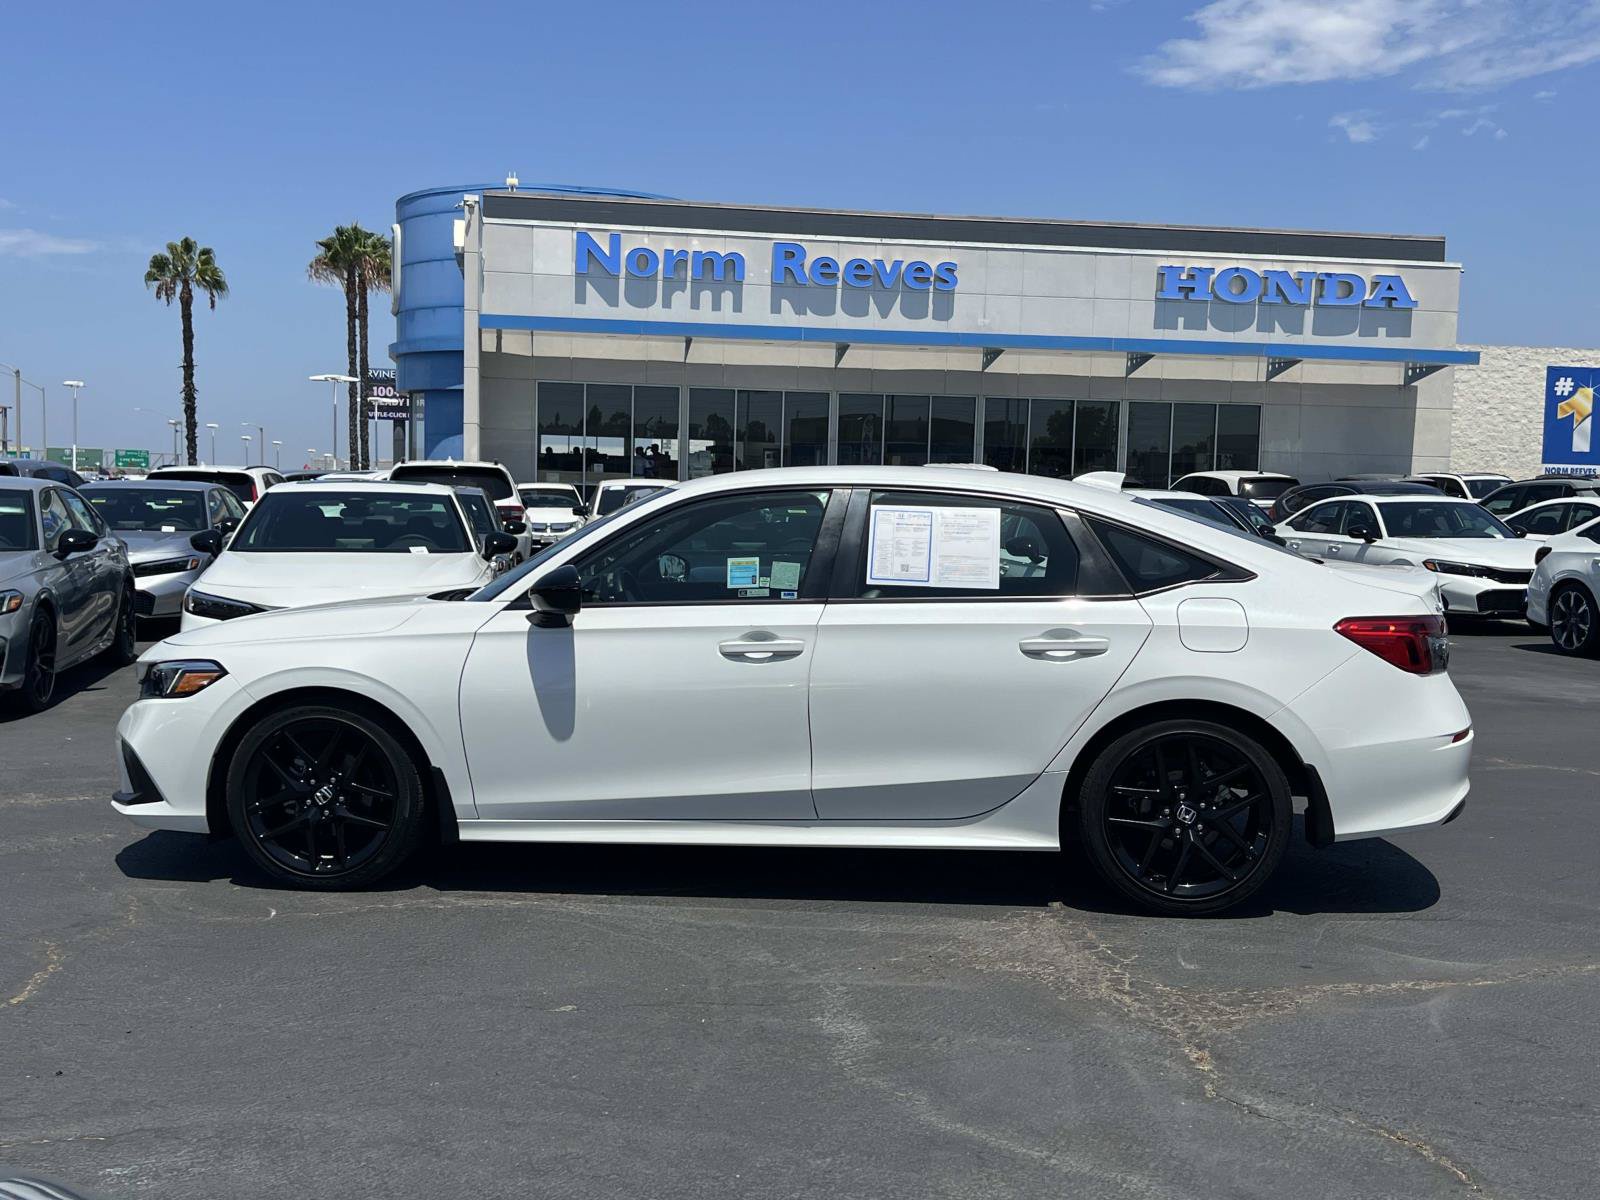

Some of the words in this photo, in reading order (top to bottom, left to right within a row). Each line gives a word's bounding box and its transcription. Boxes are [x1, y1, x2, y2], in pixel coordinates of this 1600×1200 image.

[575, 231, 746, 281] Norm
[772, 241, 959, 290] Reeves
[1156, 265, 1419, 308] HONDA
[1544, 467, 1569, 475] NORM
[1570, 467, 1597, 475] REEVES
